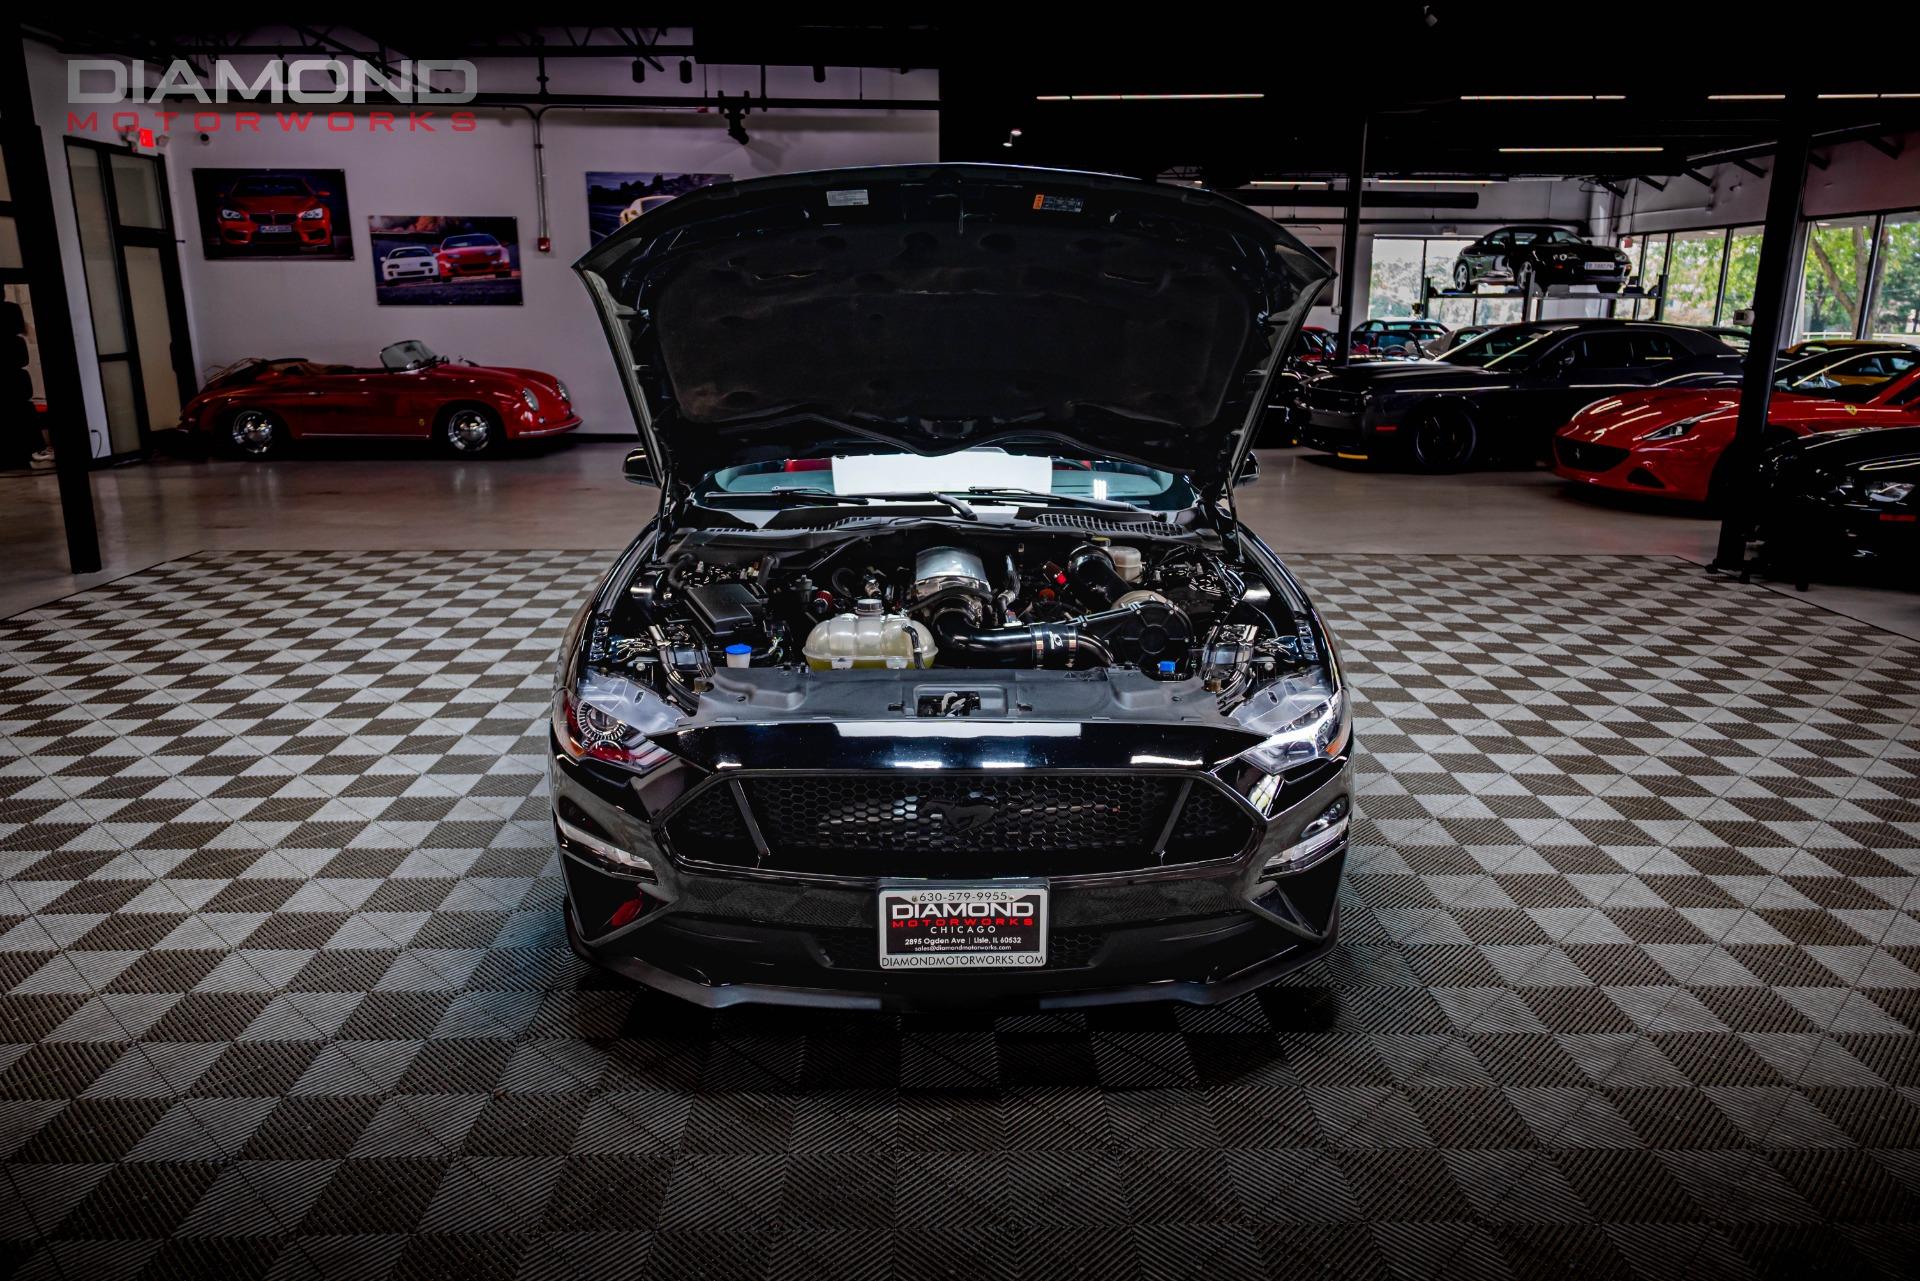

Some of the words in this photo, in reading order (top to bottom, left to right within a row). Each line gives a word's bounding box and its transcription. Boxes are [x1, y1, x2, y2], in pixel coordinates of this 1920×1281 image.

[919, 892, 1007, 902] 630-579-9955
[892, 902, 1034, 919] DIAMOND
[891, 918, 1033, 928] MOTORWORKS
[930, 925, 996, 934] CHICAGO
[904, 938, 922, 946] 2895
[923, 937, 950, 946] Ogden
[1000, 936, 1022, 944] 60532
[914, 944, 1012, 952] sales@diamondmotorworks.com
[881, 955, 1045, 967] DIAMONDMOTORWORKS.COM
